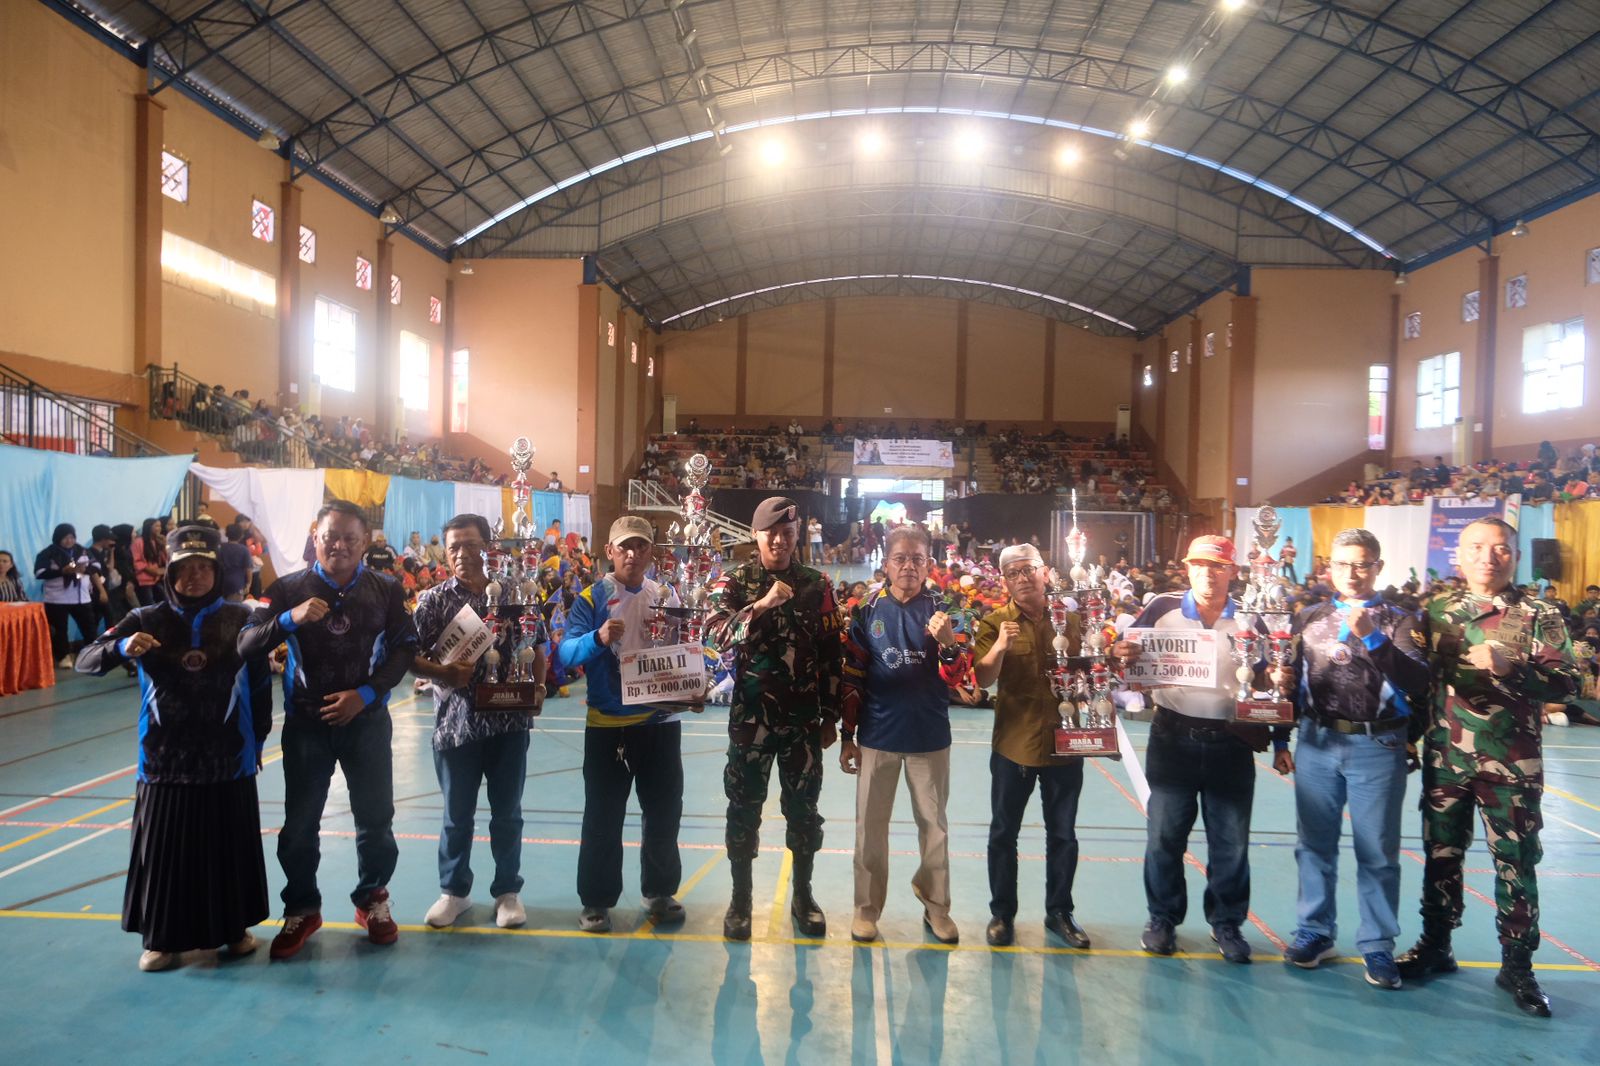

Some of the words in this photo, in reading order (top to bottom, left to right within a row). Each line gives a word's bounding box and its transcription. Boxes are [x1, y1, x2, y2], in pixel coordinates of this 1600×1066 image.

[457, 625, 466, 636] I
[1141, 638, 1198, 653] FAVORIT
[638, 656, 673, 675] JUARA
[677, 654, 686, 668] II
[1129, 665, 1148, 677] Rp.
[1151, 664, 1210, 679] 7.500.000
[627, 687, 644, 698] Rp.
[646, 678, 701, 695] 12.000.000
